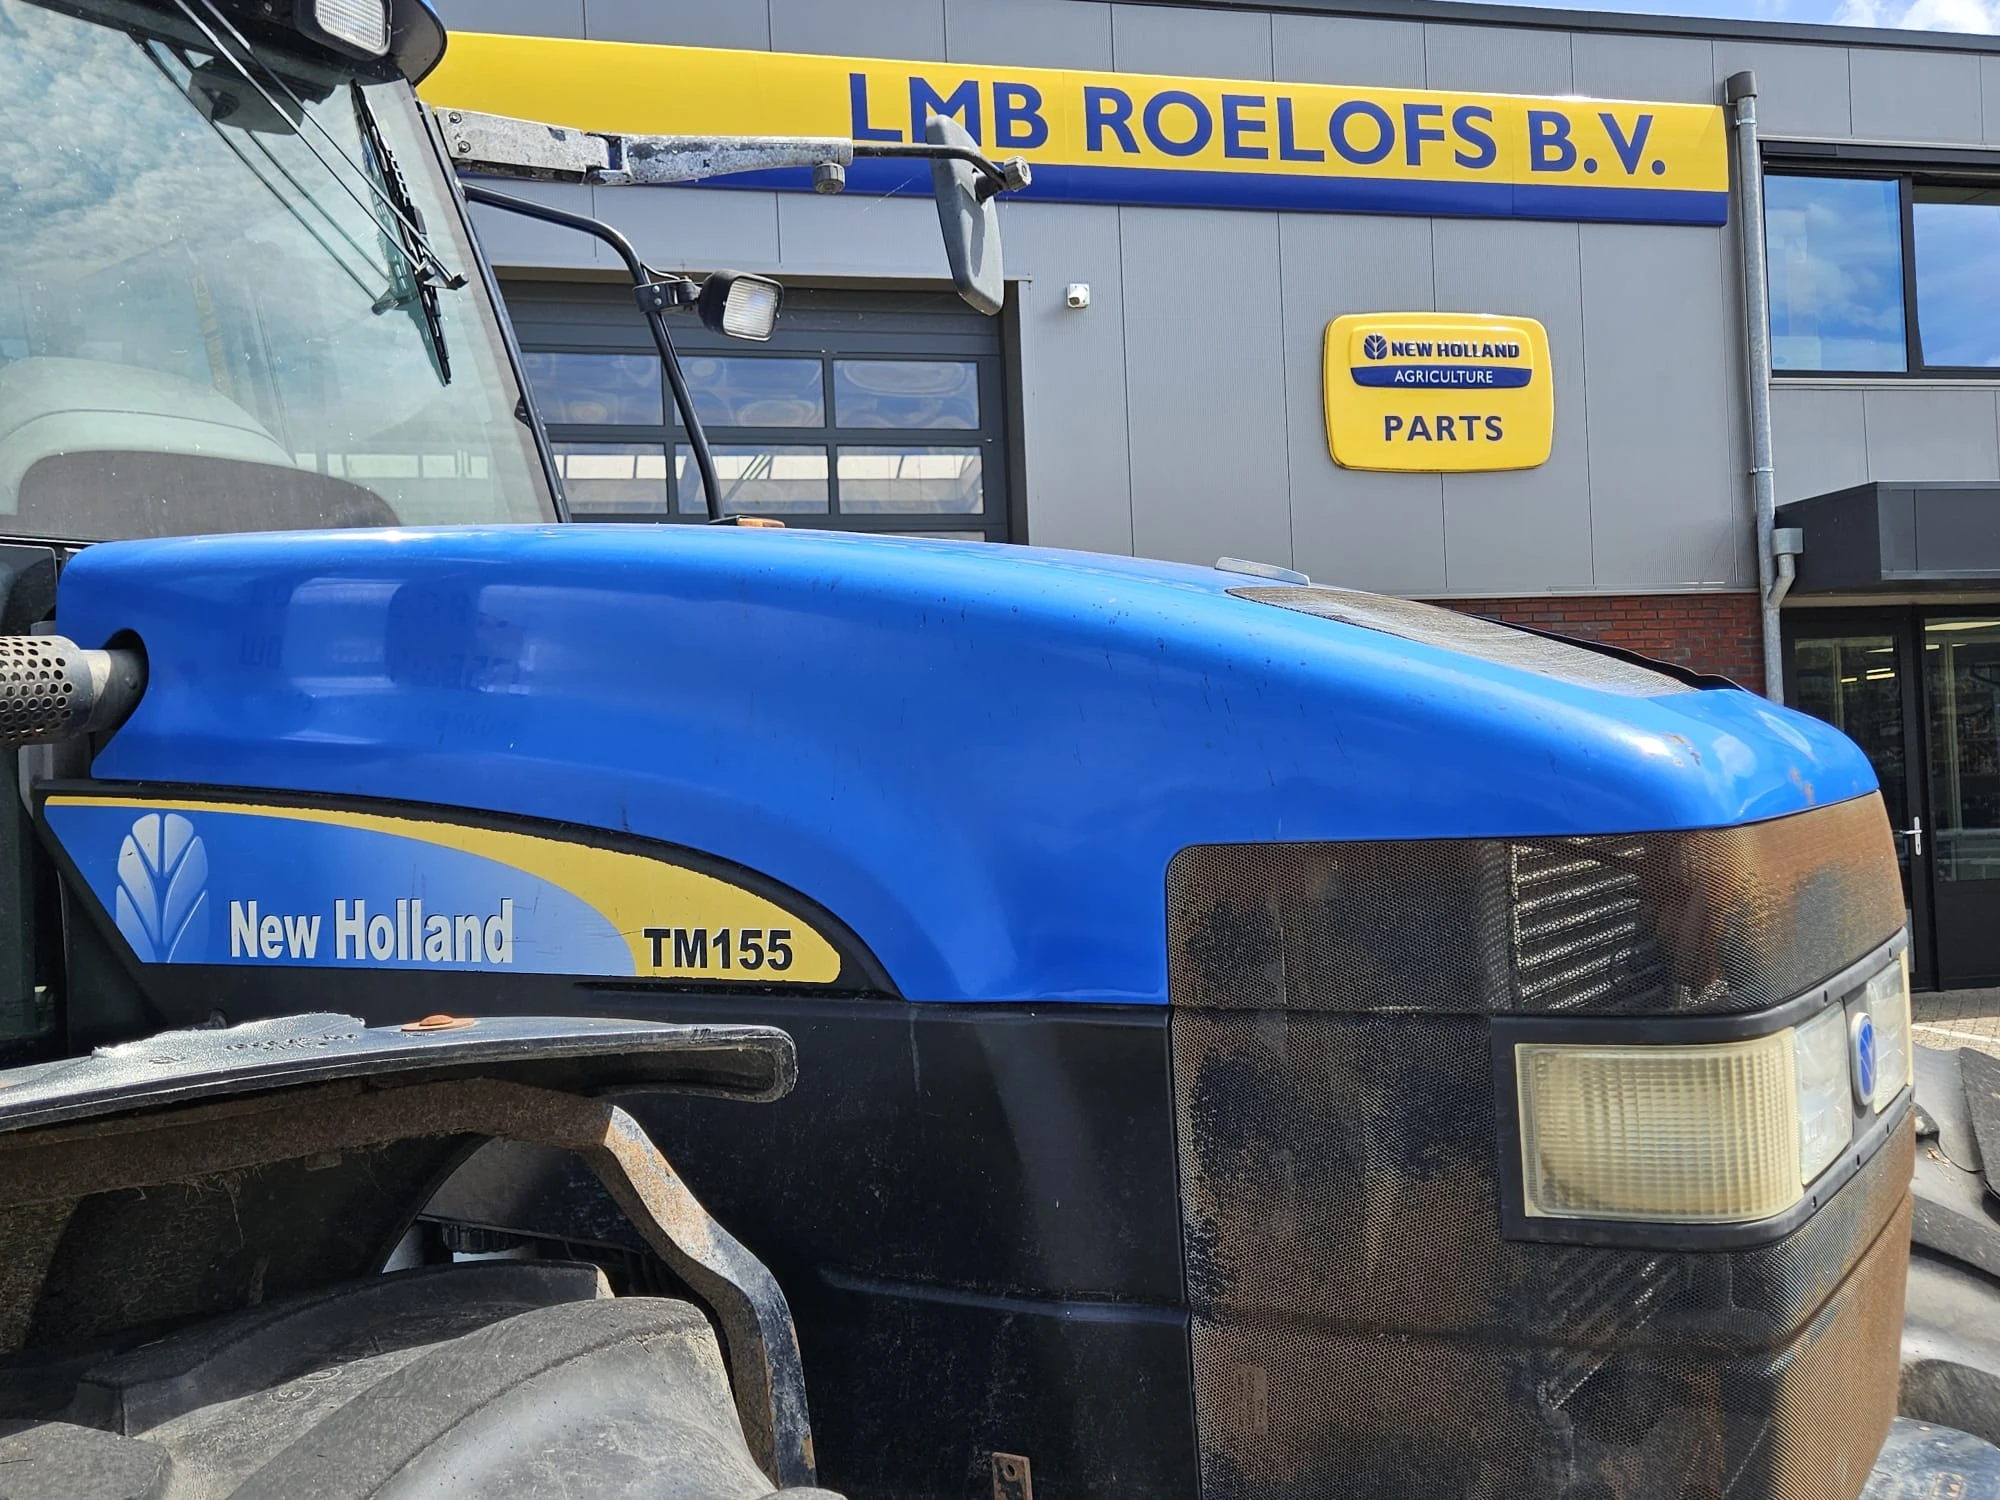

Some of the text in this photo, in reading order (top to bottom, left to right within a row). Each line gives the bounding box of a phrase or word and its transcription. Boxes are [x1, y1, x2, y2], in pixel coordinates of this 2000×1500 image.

[849, 73, 1666, 175] LMB ROELOFS B.V.
[1392, 341, 1520, 359] NEW HOLLAND
[1394, 370, 1493, 384] AGRICULTURE
[1384, 415, 1503, 441] PARTS
[230, 897, 793, 971] New Holland TM155
